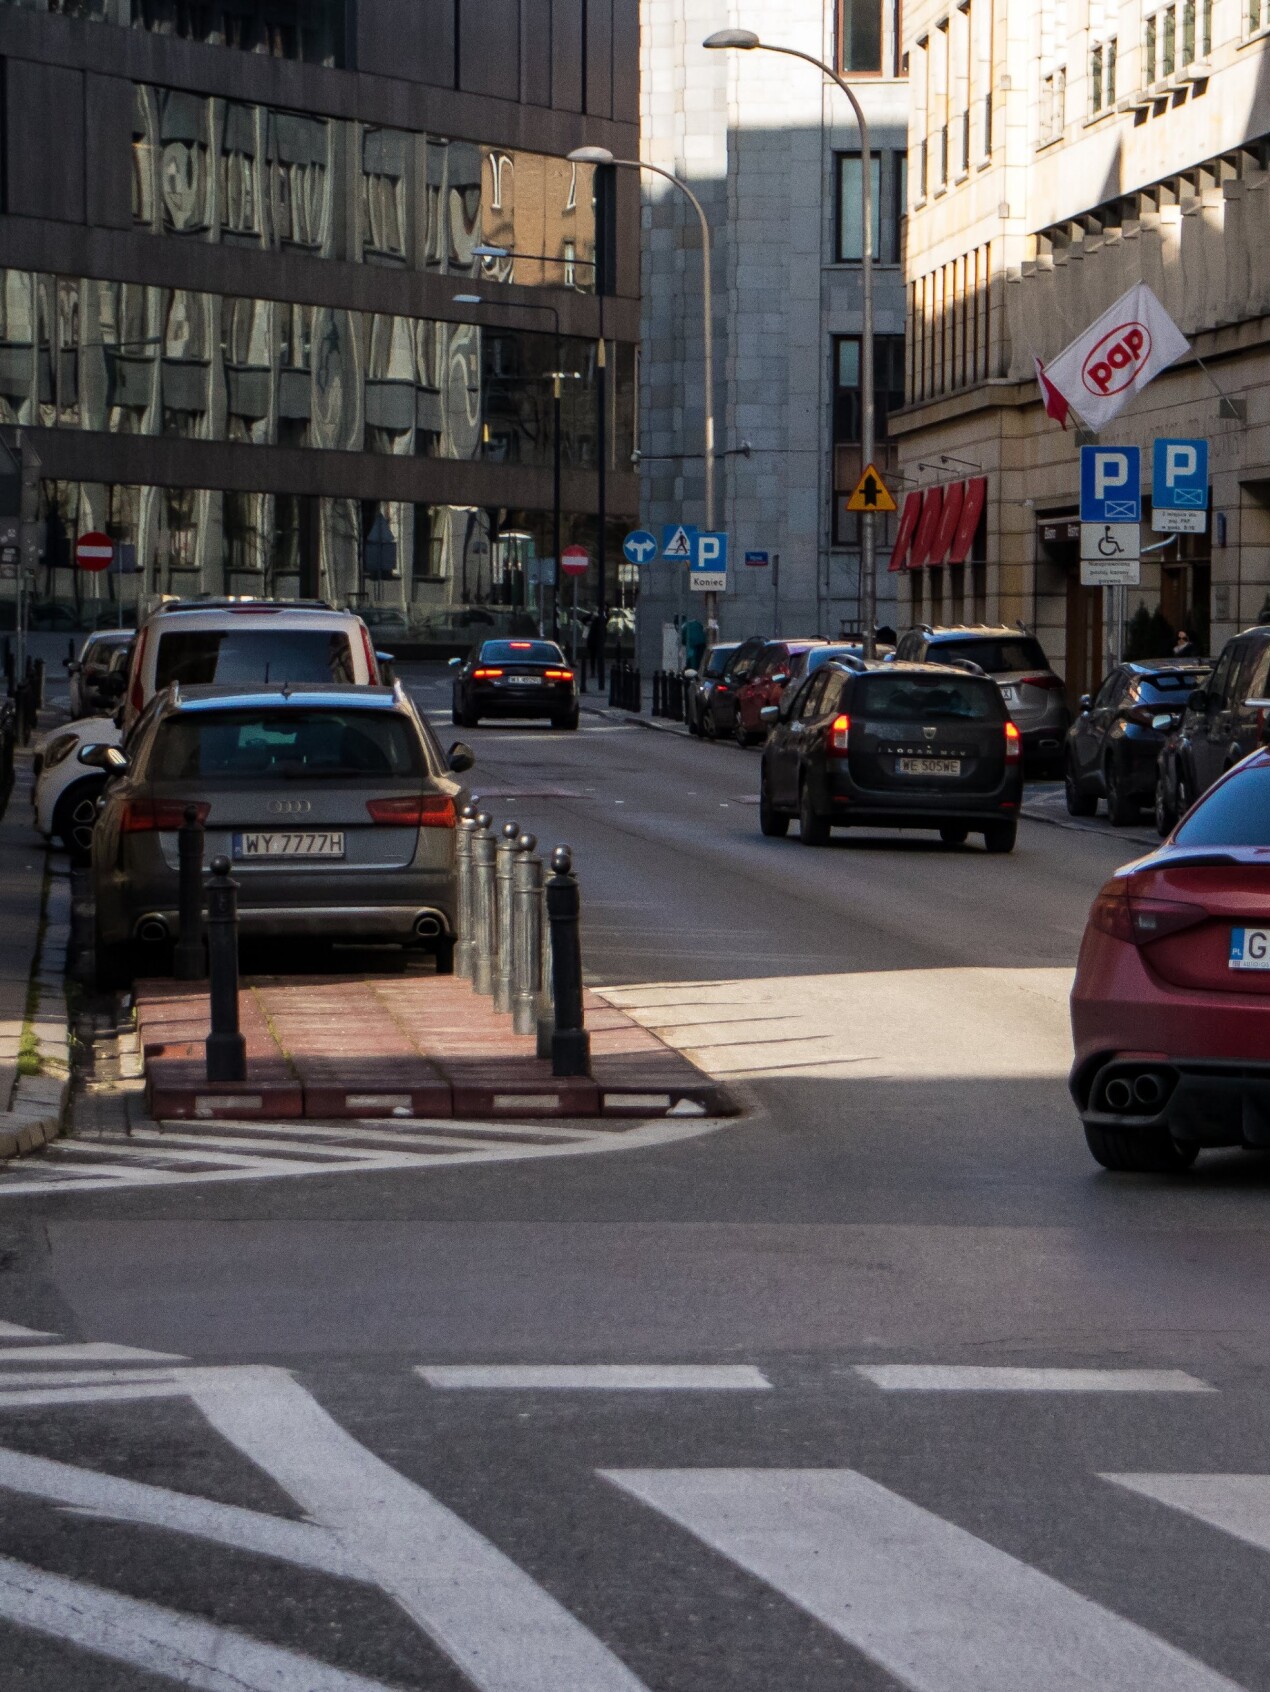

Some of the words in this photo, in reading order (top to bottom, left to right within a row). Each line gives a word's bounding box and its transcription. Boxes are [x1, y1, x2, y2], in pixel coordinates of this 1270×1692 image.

[1095, 453, 1128, 499] P
[1166, 445, 1197, 487] P
[698, 537, 720, 567] P
[693, 578, 723, 586] Koniec
[246, 834, 274, 853] WY
[281, 834, 342, 852] 7777H
